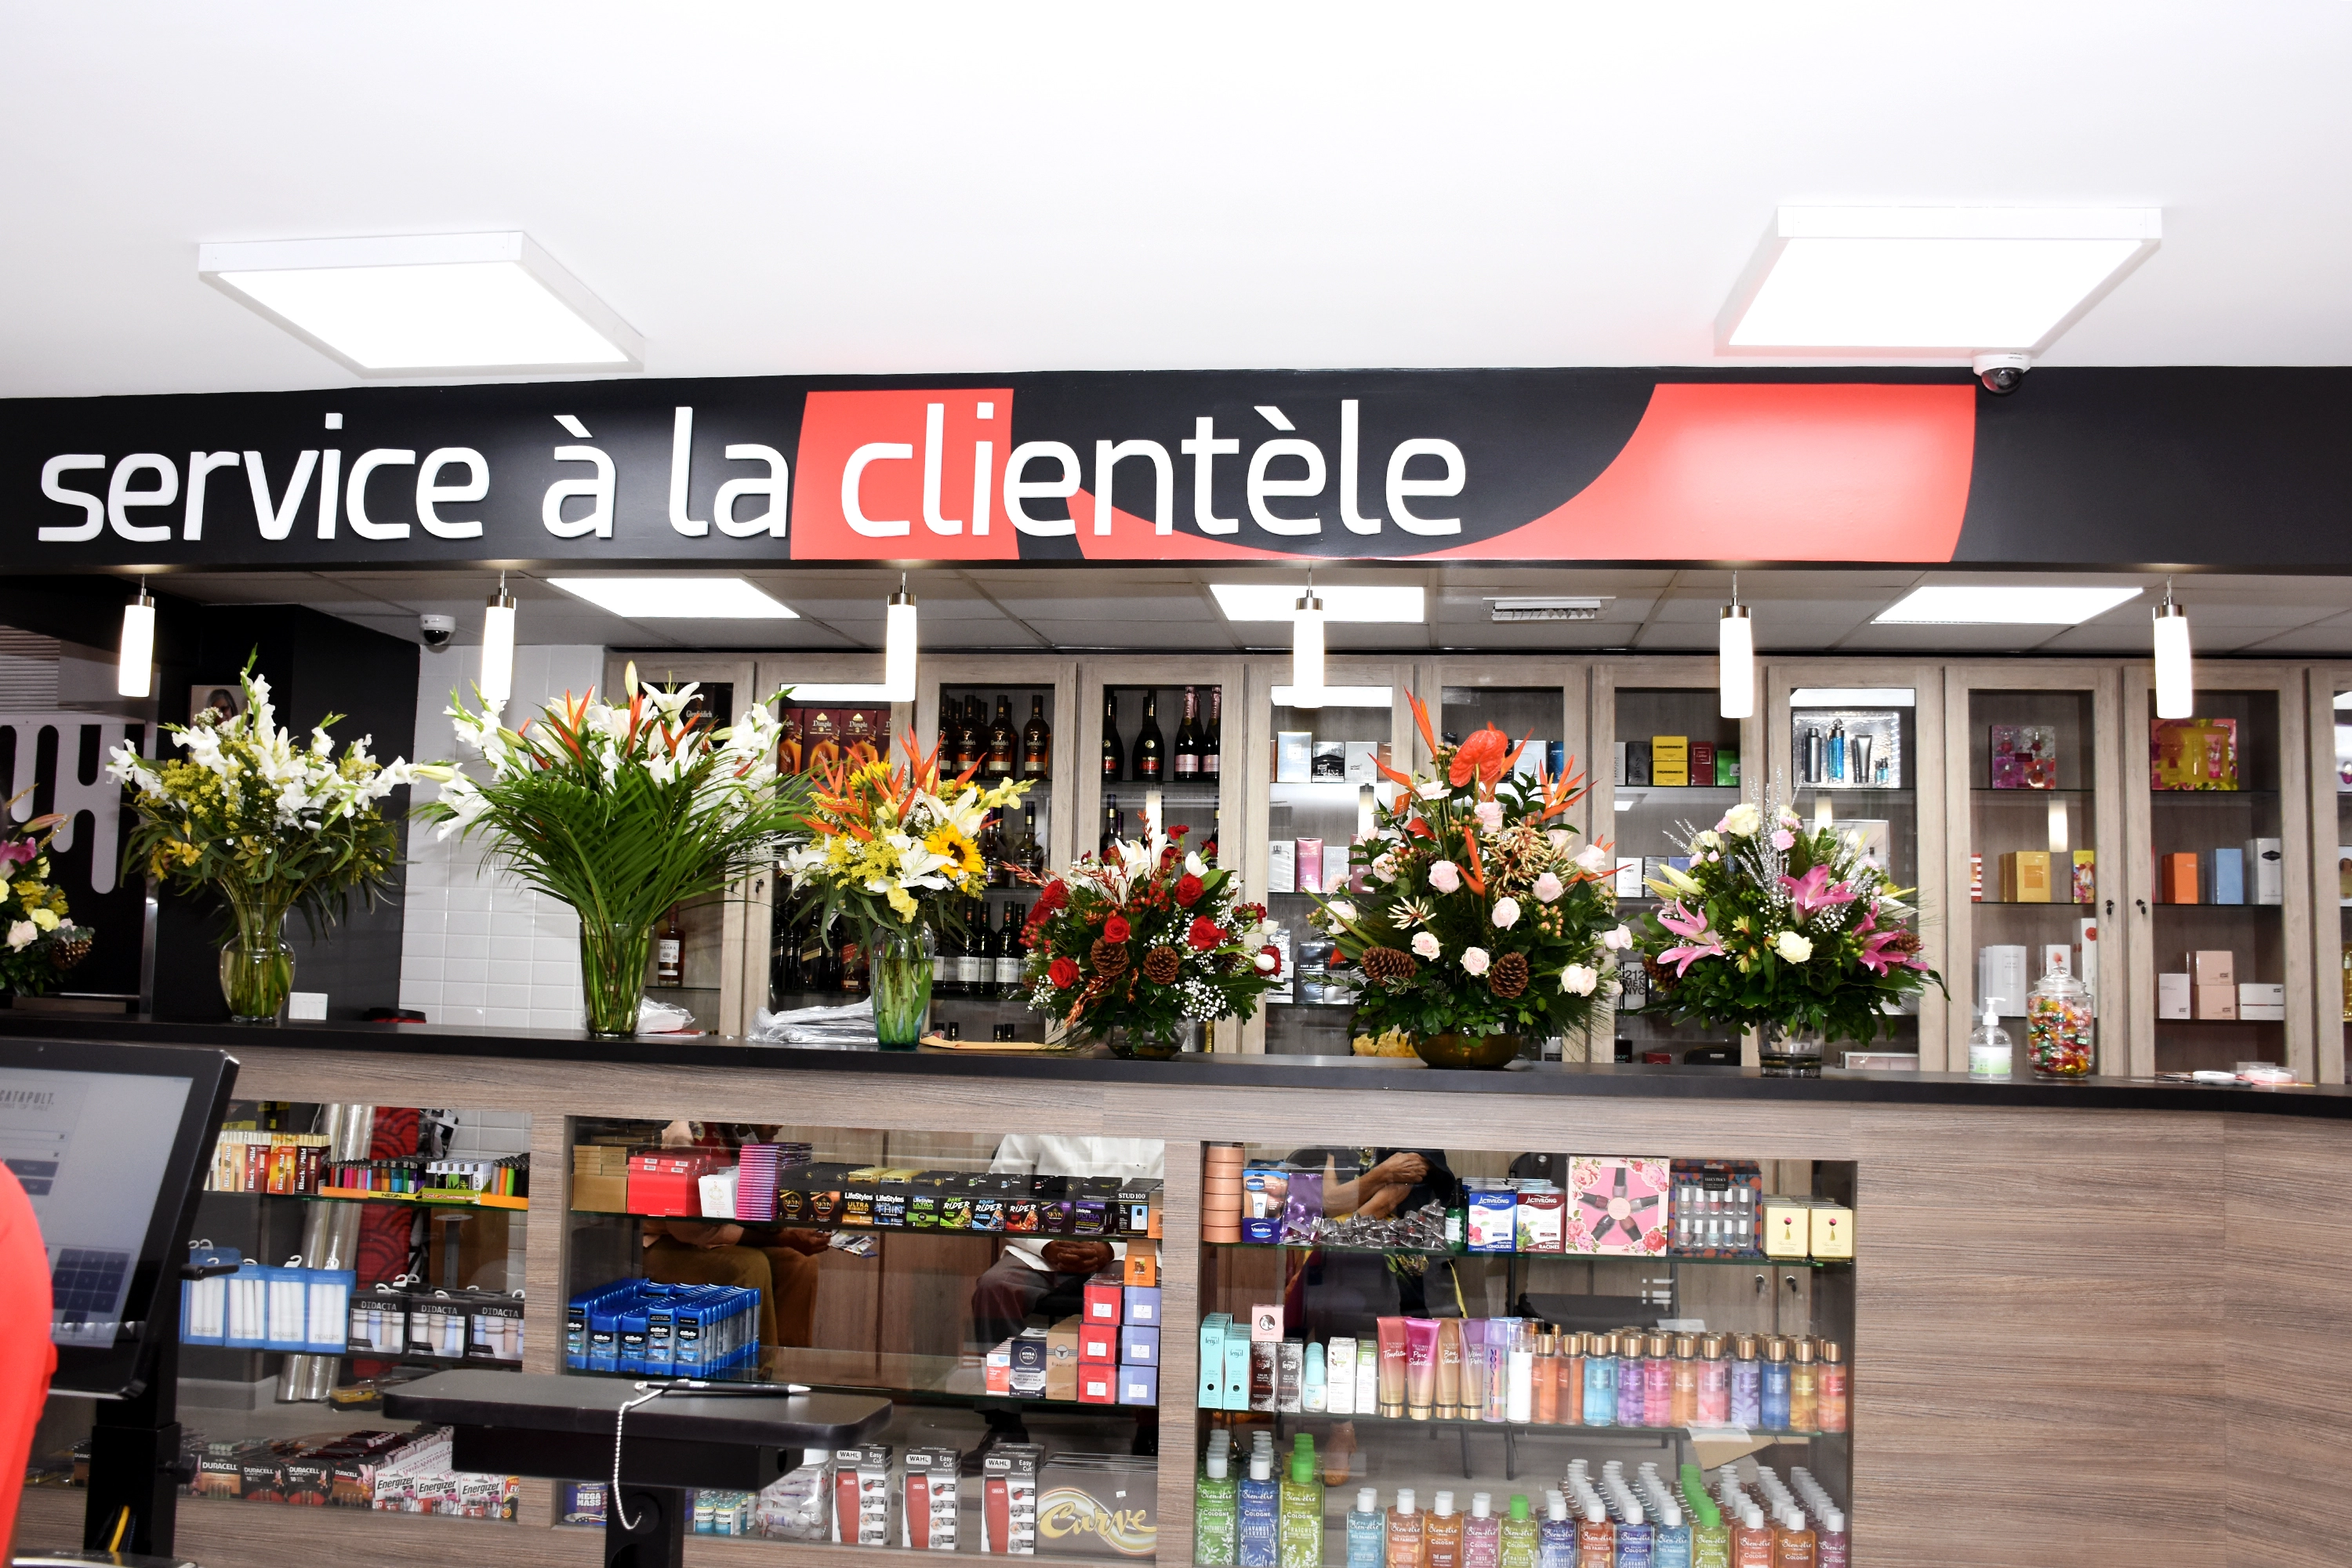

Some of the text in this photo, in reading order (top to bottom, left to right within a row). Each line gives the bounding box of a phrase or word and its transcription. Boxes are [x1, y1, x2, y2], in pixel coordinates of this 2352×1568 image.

[38, 399, 1465, 541] service à la clientèle
[1624, 970, 1645, 979] 212
[844, 1192, 873, 1201] LifeStyles
[1477, 1196, 1509, 1205] ACTIVILONG
[1525, 1195, 1557, 1205] ACTIVILONG
[878, 1205, 903, 1214] THIN
[361, 1301, 397, 1311] DIDACTA
[421, 1305, 458, 1315] DIDACTA
[482, 1307, 519, 1318] DIDACTA
[1205, 1337, 1219, 1345] fenjal
[1230, 1349, 1243, 1358] fenjal
[1282, 1361, 1296, 1370] fenjal
[1409, 1358, 1432, 1367] Seduction
[202, 1461, 238, 1471] DURACELL
[289, 1466, 320, 1475] DURACELL
[335, 1469, 358, 1478] DURACELL
[377, 1476, 415, 1490] Energizer
[419, 1480, 456, 1493] Energizer
[462, 1483, 499, 1495] Energizer
[1201, 1490, 1232, 1499] Bien-être
[1243, 1490, 1273, 1499] Bien-être
[1285, 1492, 1316, 1501] Bien-être
[1040, 1501, 1157, 1538] Curve
[1349, 1520, 1379, 1530] Bien-être
[1391, 1523, 1421, 1533] Bien-être
[1428, 1524, 1457, 1534] Bien-être
[1467, 1526, 1495, 1536] Bien-être
[1504, 1527, 1533, 1537] Bien-être
[1544, 1529, 1573, 1538] Bien-être
[1582, 1531, 1612, 1541] Bien-être
[1621, 1532, 1650, 1541] Bien-être
[1657, 1534, 1687, 1543] Bien-être
[1697, 1534, 1726, 1544] Bien-être
[1740, 1537, 1770, 1547] Bien-être
[1781, 1539, 1812, 1548] Bien-être
